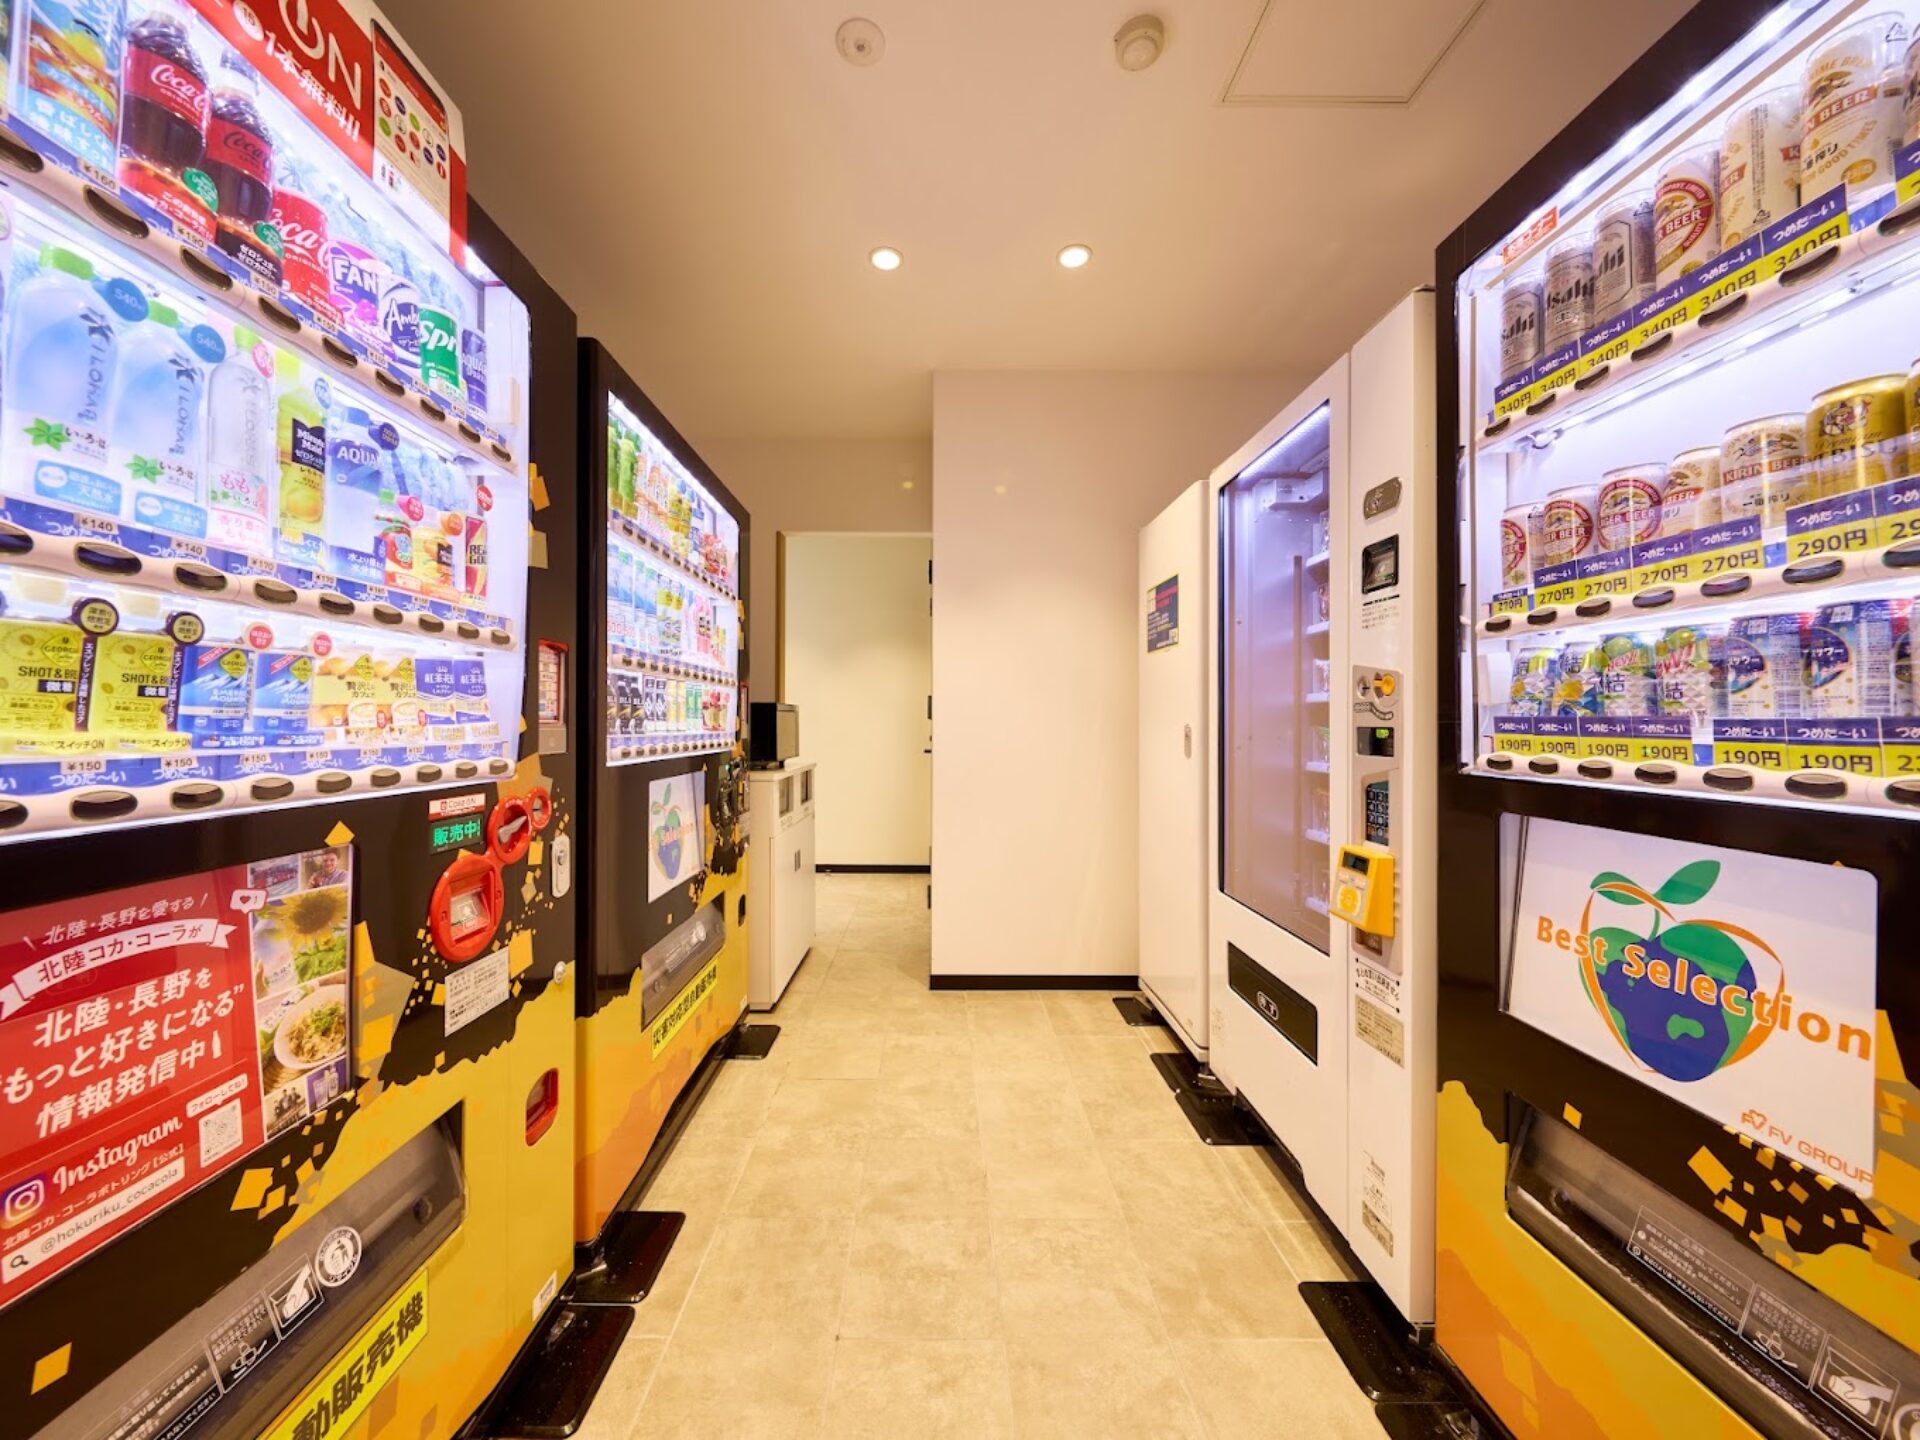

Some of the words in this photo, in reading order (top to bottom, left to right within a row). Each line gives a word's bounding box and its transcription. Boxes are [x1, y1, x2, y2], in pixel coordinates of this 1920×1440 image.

[1819, 90, 1870, 121] BEER
[1665, 209, 1702, 234] BEER
[1773, 224, 1841, 273] 340円
[1699, 270, 1757, 313] 340円
[1639, 306, 1688, 344] 340円
[1586, 340, 1629, 369] 340円
[1540, 368, 1576, 395] 340円
[1498, 391, 1532, 417] 340円
[81, 517, 114, 532] ¥140
[176, 541, 203, 556] ¥140
[1797, 528, 1868, 557] 290円
[1702, 549, 1759, 573] 270円
[1584, 576, 1627, 597] 270円
[1640, 564, 1688, 585] 270円
[1498, 599, 1523, 611] 270円
[1539, 587, 1574, 605] 270円
[18, 665, 53, 677] SHOT
[54, 668, 63, 678] &
[121, 672, 149, 684] SHOT
[150, 674, 159, 684] &
[1500, 739, 1531, 751] 190円
[1540, 742, 1577, 755] 190円
[1587, 743, 1629, 757] 190円
[1642, 745, 1689, 760] 190円
[67, 761, 101, 772] ¥150
[165, 757, 193, 768] ¥150
[1723, 750, 1781, 767] 190円
[1801, 754, 1874, 773] 190円
[433, 820, 478, 846] 販売中
[41, 895, 195, 947] 北陸・長野を愛する
[38, 923, 204, 983] 北陸コカ・コーラが
[1535, 915, 1609, 965] Best
[1621, 942, 1874, 1063] Selection
[33, 967, 212, 1048] 北陸・長野を
[53, 1116, 183, 1194] Instagram
[1768, 1125, 1793, 1146] FV
[1797, 1140, 1874, 1184] GROUP
